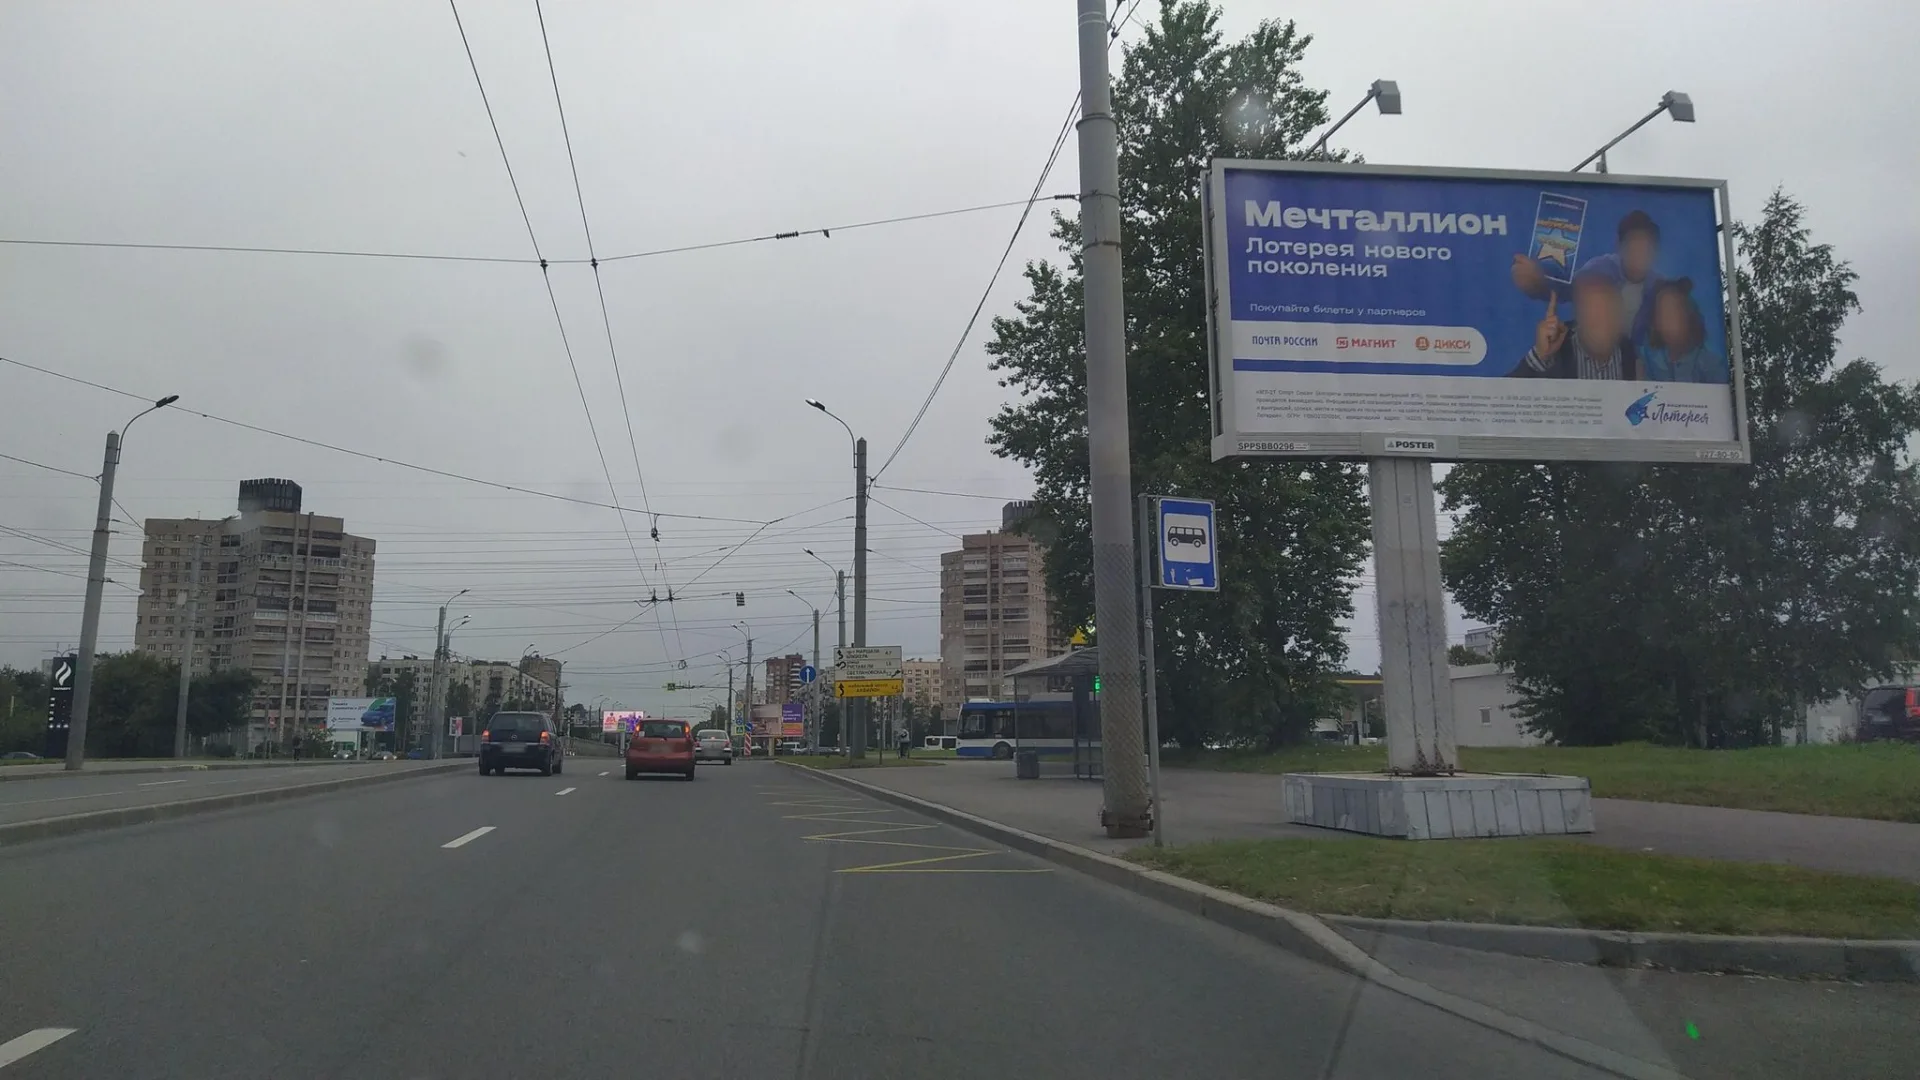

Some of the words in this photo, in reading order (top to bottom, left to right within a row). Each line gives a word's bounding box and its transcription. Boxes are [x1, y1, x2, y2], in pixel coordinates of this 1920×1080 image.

[1244, 199, 1507, 237] Мечталлион
[1246, 236, 1355, 260] Лотерея
[1364, 242, 1452, 262] нового
[1248, 259, 1388, 279] поколения
[1250, 303, 1310, 315] Покупайте
[1313, 305, 1354, 315] билеты
[1357, 307, 1365, 316] у
[1367, 307, 1427, 318] партнеров
[1251, 335, 1281, 346] ПОЧТА
[1284, 336, 1318, 347] РОССИИ
[1351, 338, 1397, 349] МАГНИТ
[1433, 339, 1471, 351] ДИКСИ
[1652, 403, 1710, 428] Лотерея
[1395, 440, 1435, 450] POSTER
